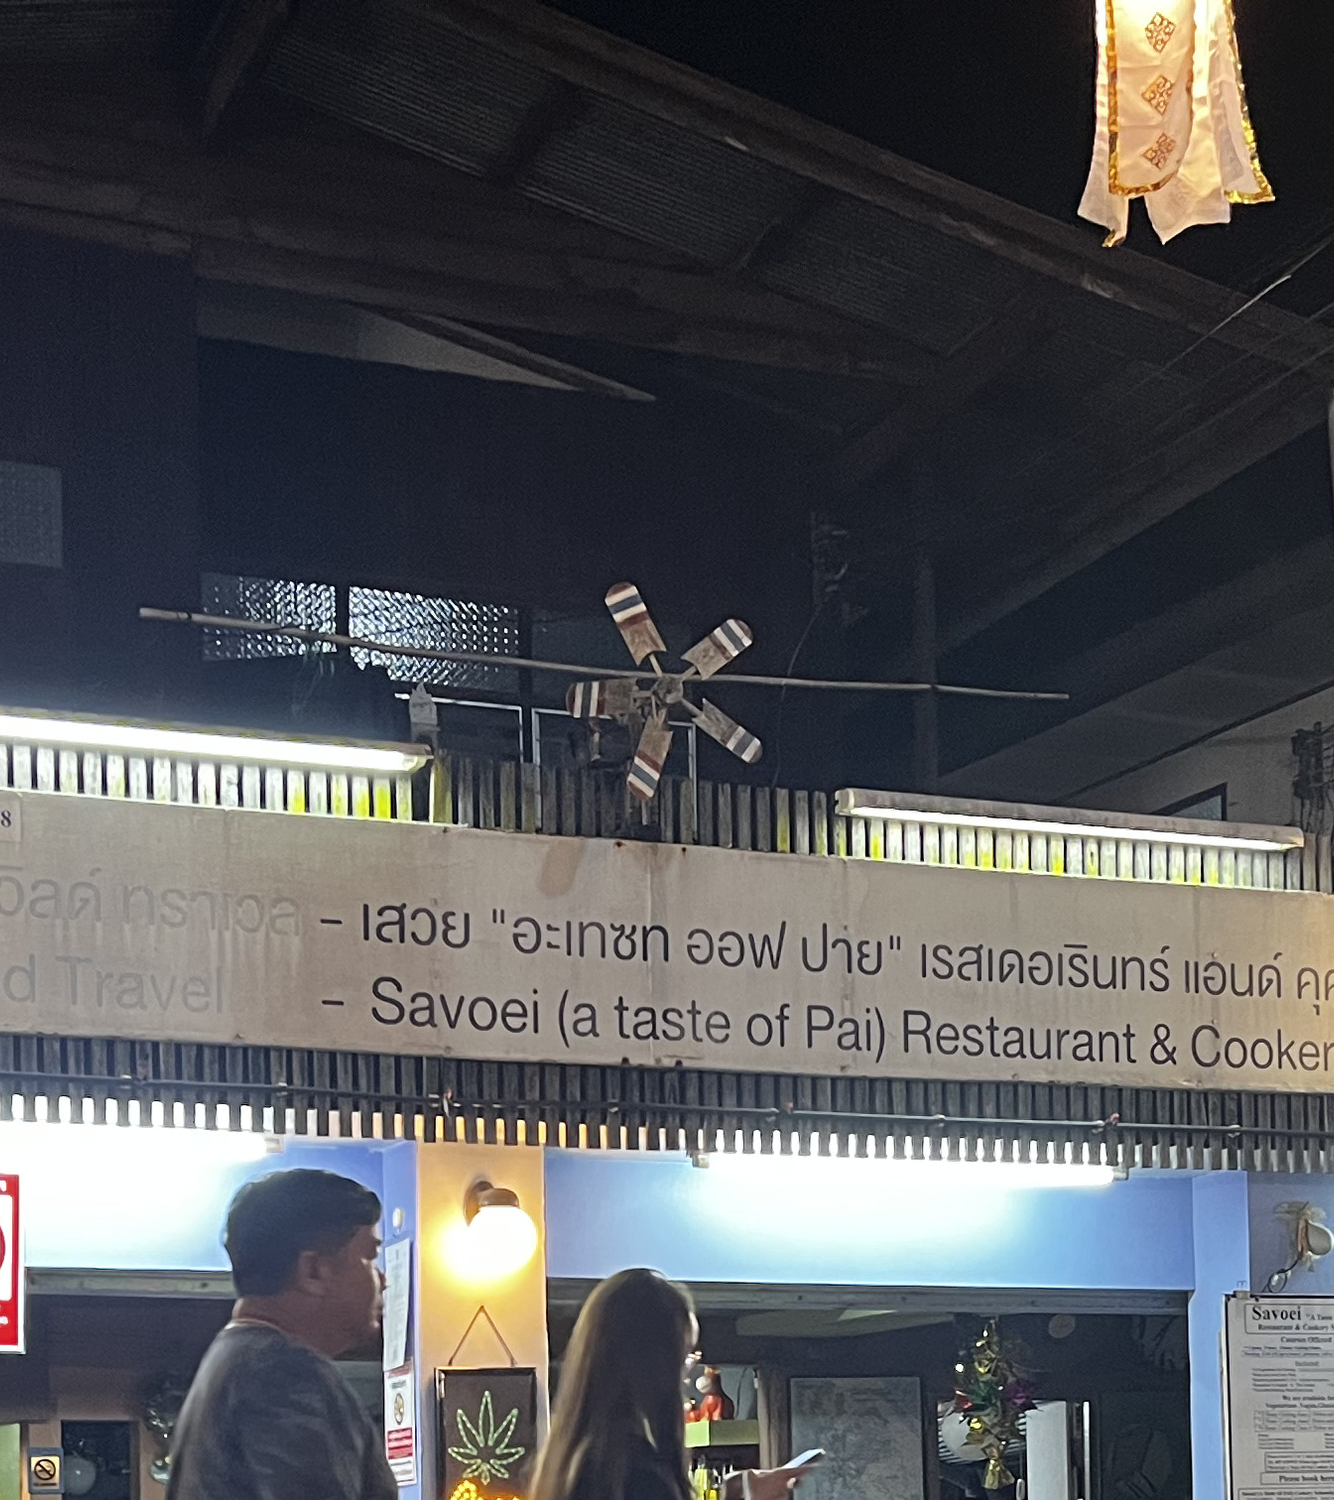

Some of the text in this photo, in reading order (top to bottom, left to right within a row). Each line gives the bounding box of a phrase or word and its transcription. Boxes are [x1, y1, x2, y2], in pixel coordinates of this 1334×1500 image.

[362, 903, 471, 949] เสวย
[686, 920, 787, 970] ออฟ
[55, 955, 223, 1013] Travel
[371, 976, 540, 1034] Savoei
[556, 989, 599, 1047] (a
[614, 996, 731, 1044] taste
[746, 1003, 792, 1047] of
[805, 1004, 886, 1063] Pai)
[902, 1008, 1137, 1065] Restaurant
[1149, 1024, 1177, 1067] &
[1252, 1305, 1301, 1321] Savoei
